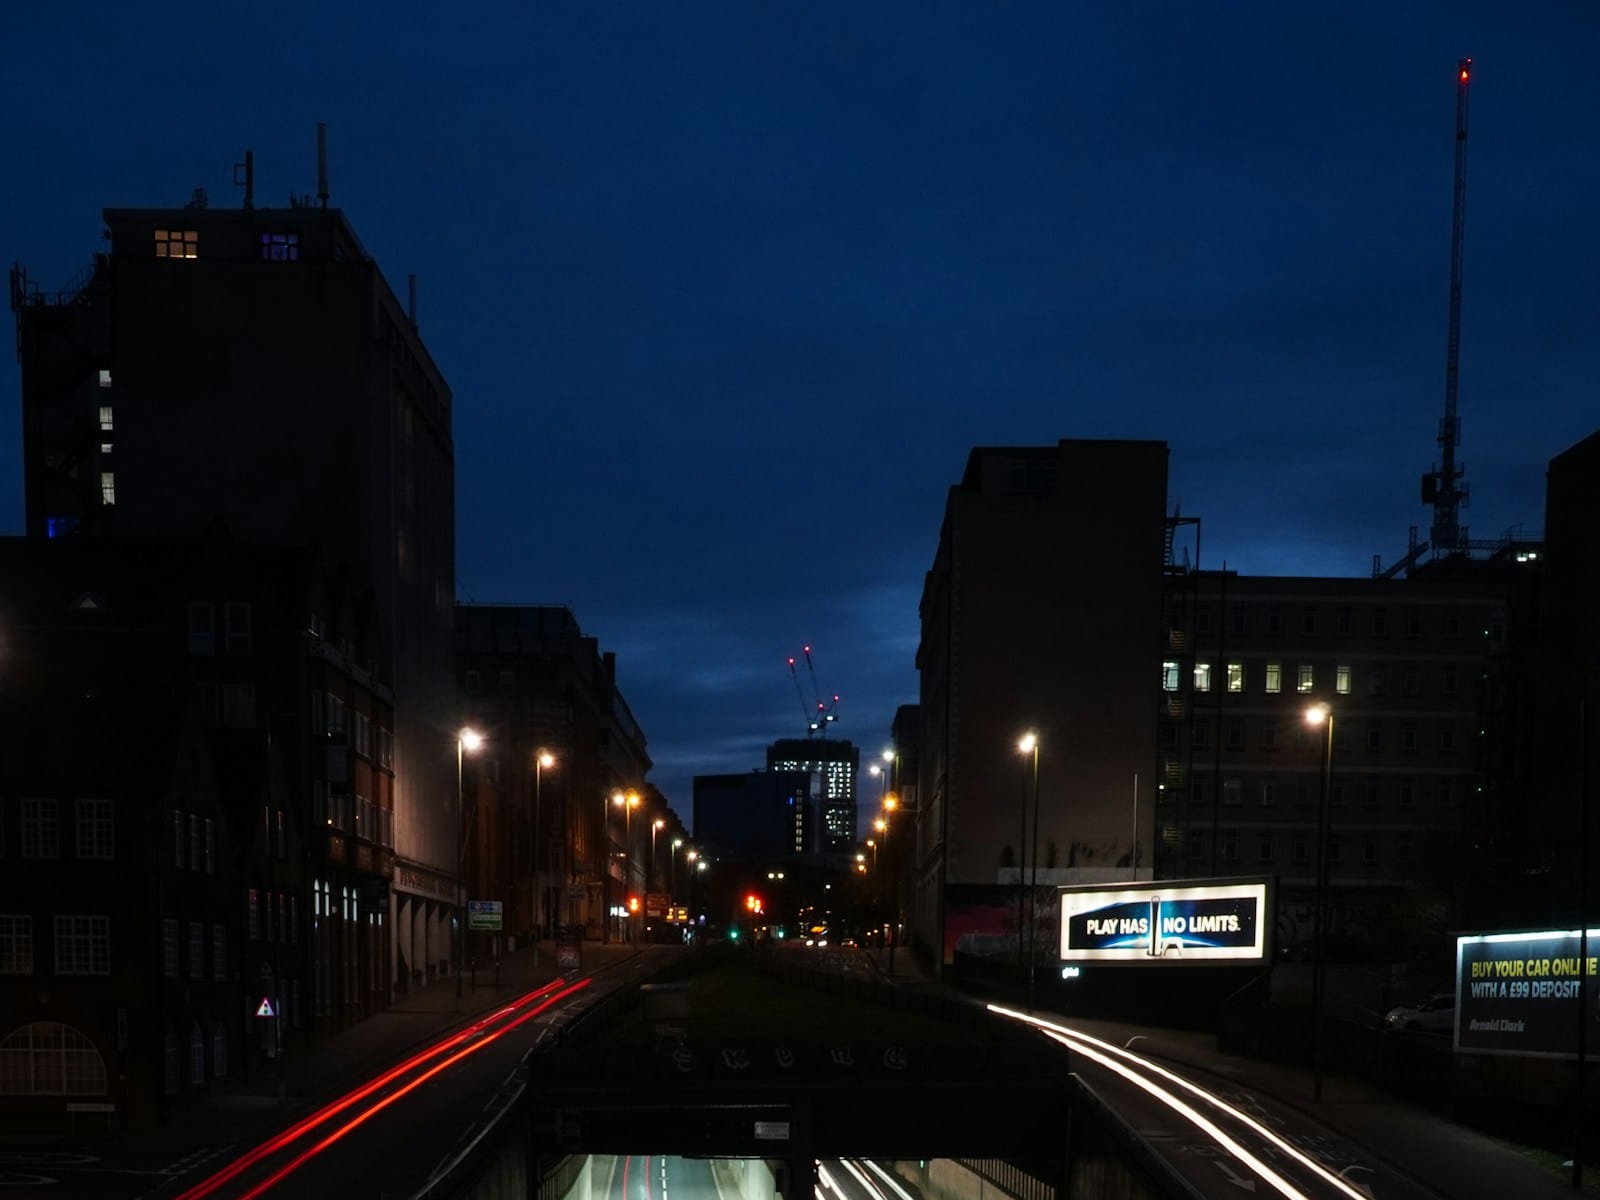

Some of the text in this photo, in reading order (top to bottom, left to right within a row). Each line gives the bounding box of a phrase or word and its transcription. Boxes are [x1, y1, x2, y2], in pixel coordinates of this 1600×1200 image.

[1086, 915, 1241, 935] PLAY HAS NO LIMITS.
[1471, 961, 1493, 978] BUY
[1494, 960, 1524, 977] YOUR
[1526, 958, 1549, 976] CAR
[1471, 980, 1581, 998] WITH A £99 DEPOSIT
